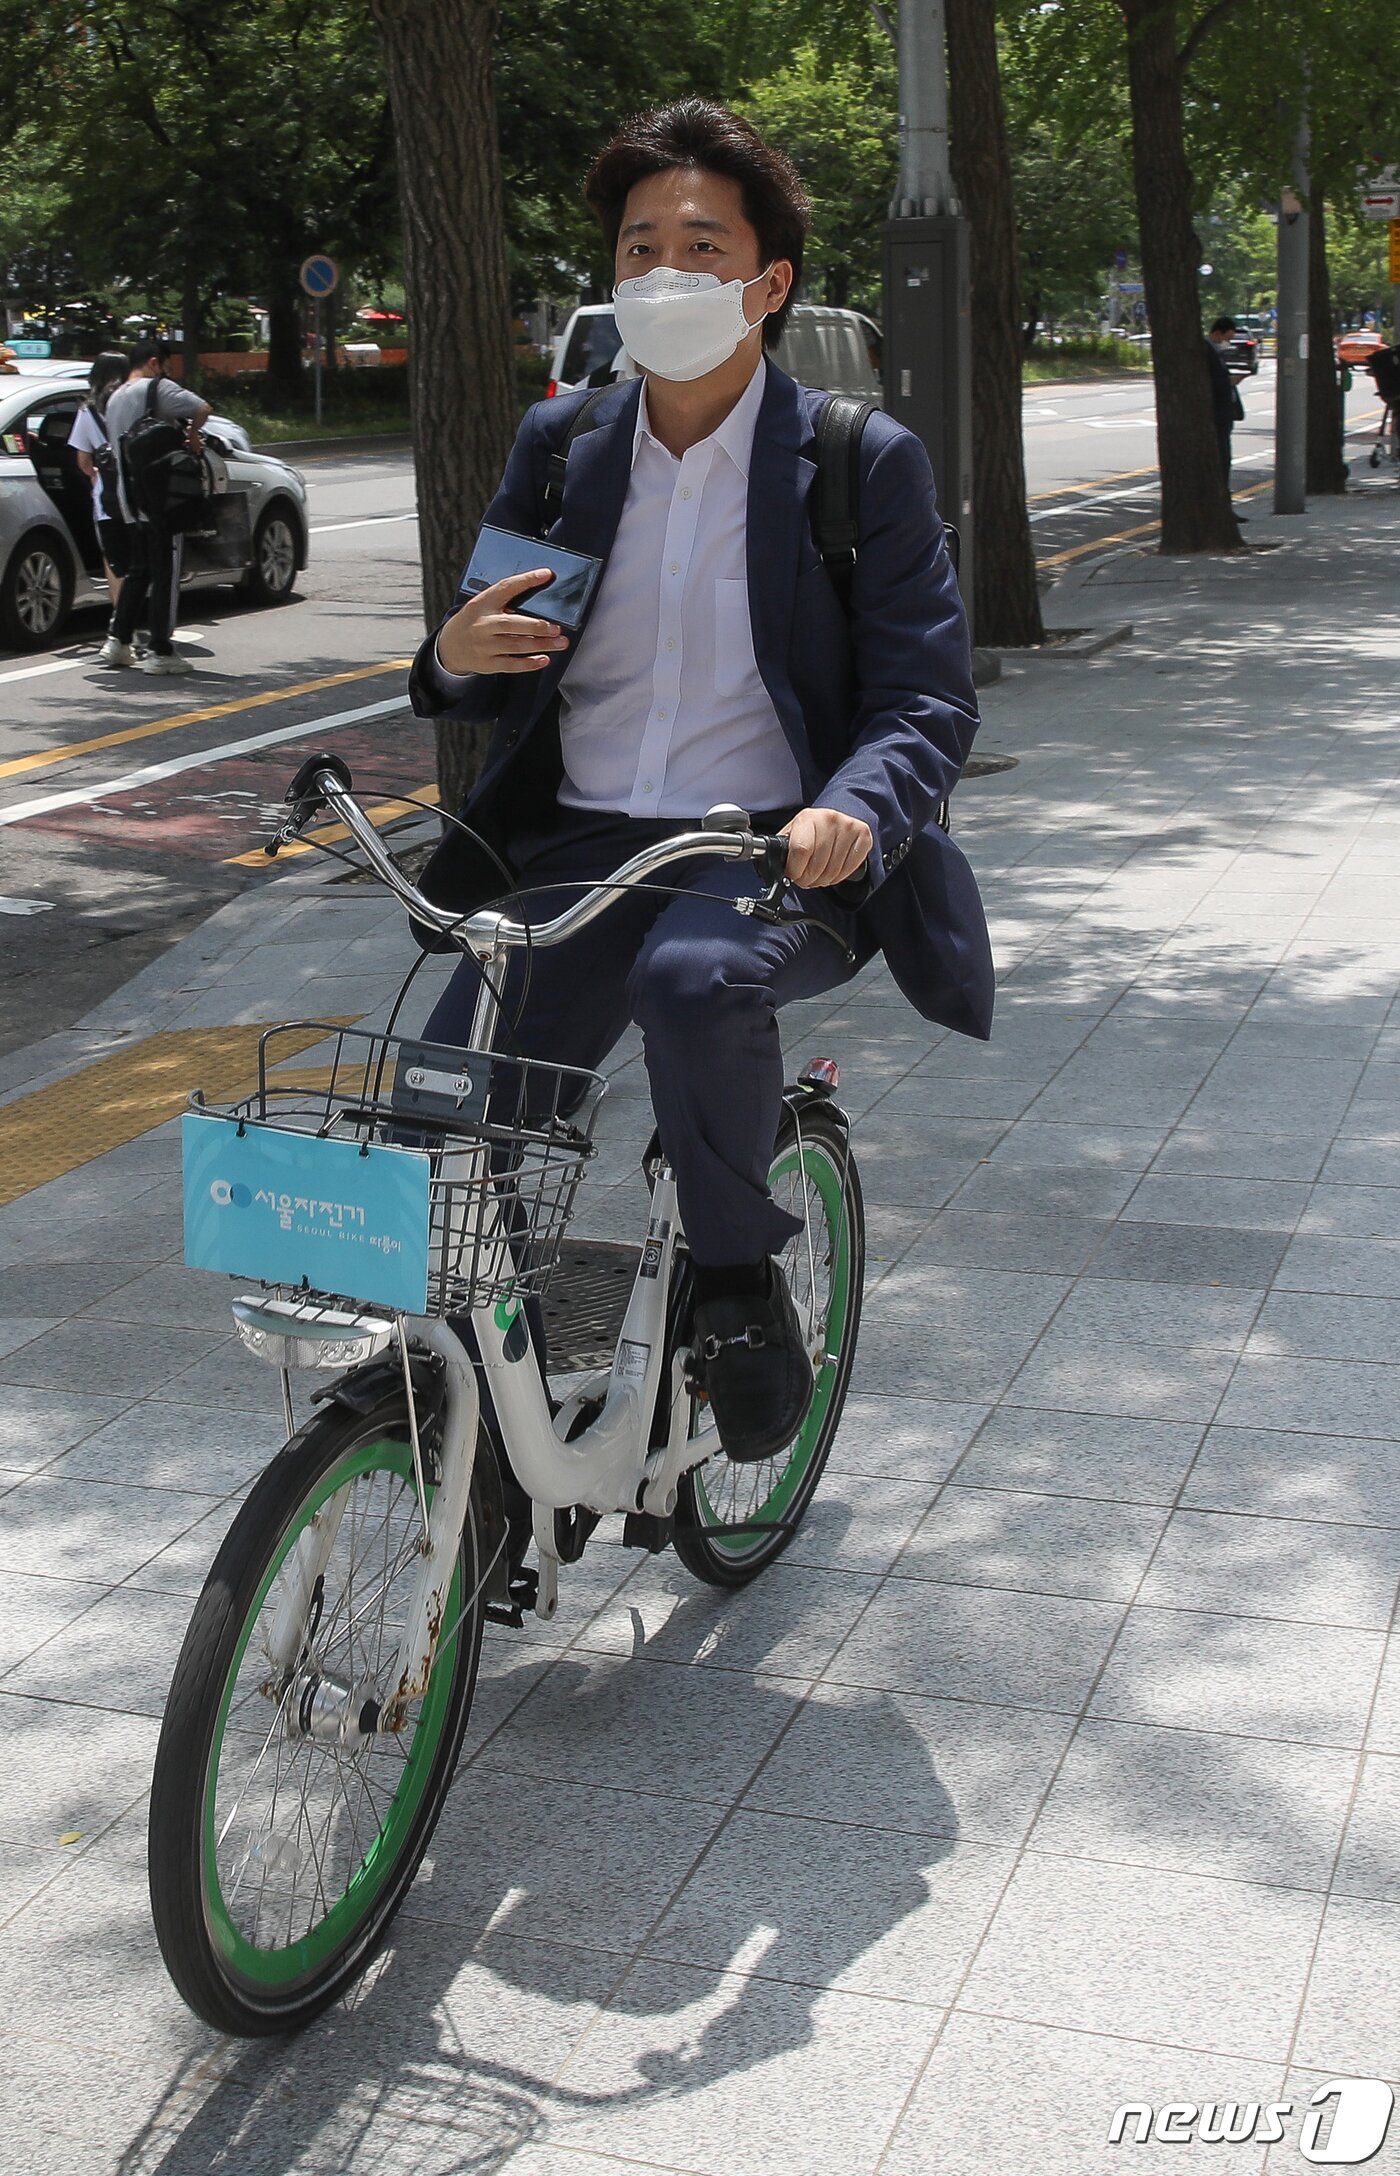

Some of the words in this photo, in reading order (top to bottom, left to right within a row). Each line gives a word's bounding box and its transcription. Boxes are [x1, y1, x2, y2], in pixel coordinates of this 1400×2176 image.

[255, 1190, 365, 1231] 서울자전거
[296, 1224, 332, 1238] SEOUL
[338, 1232, 365, 1243] BIKE
[369, 1236, 401, 1254] 따릉이
